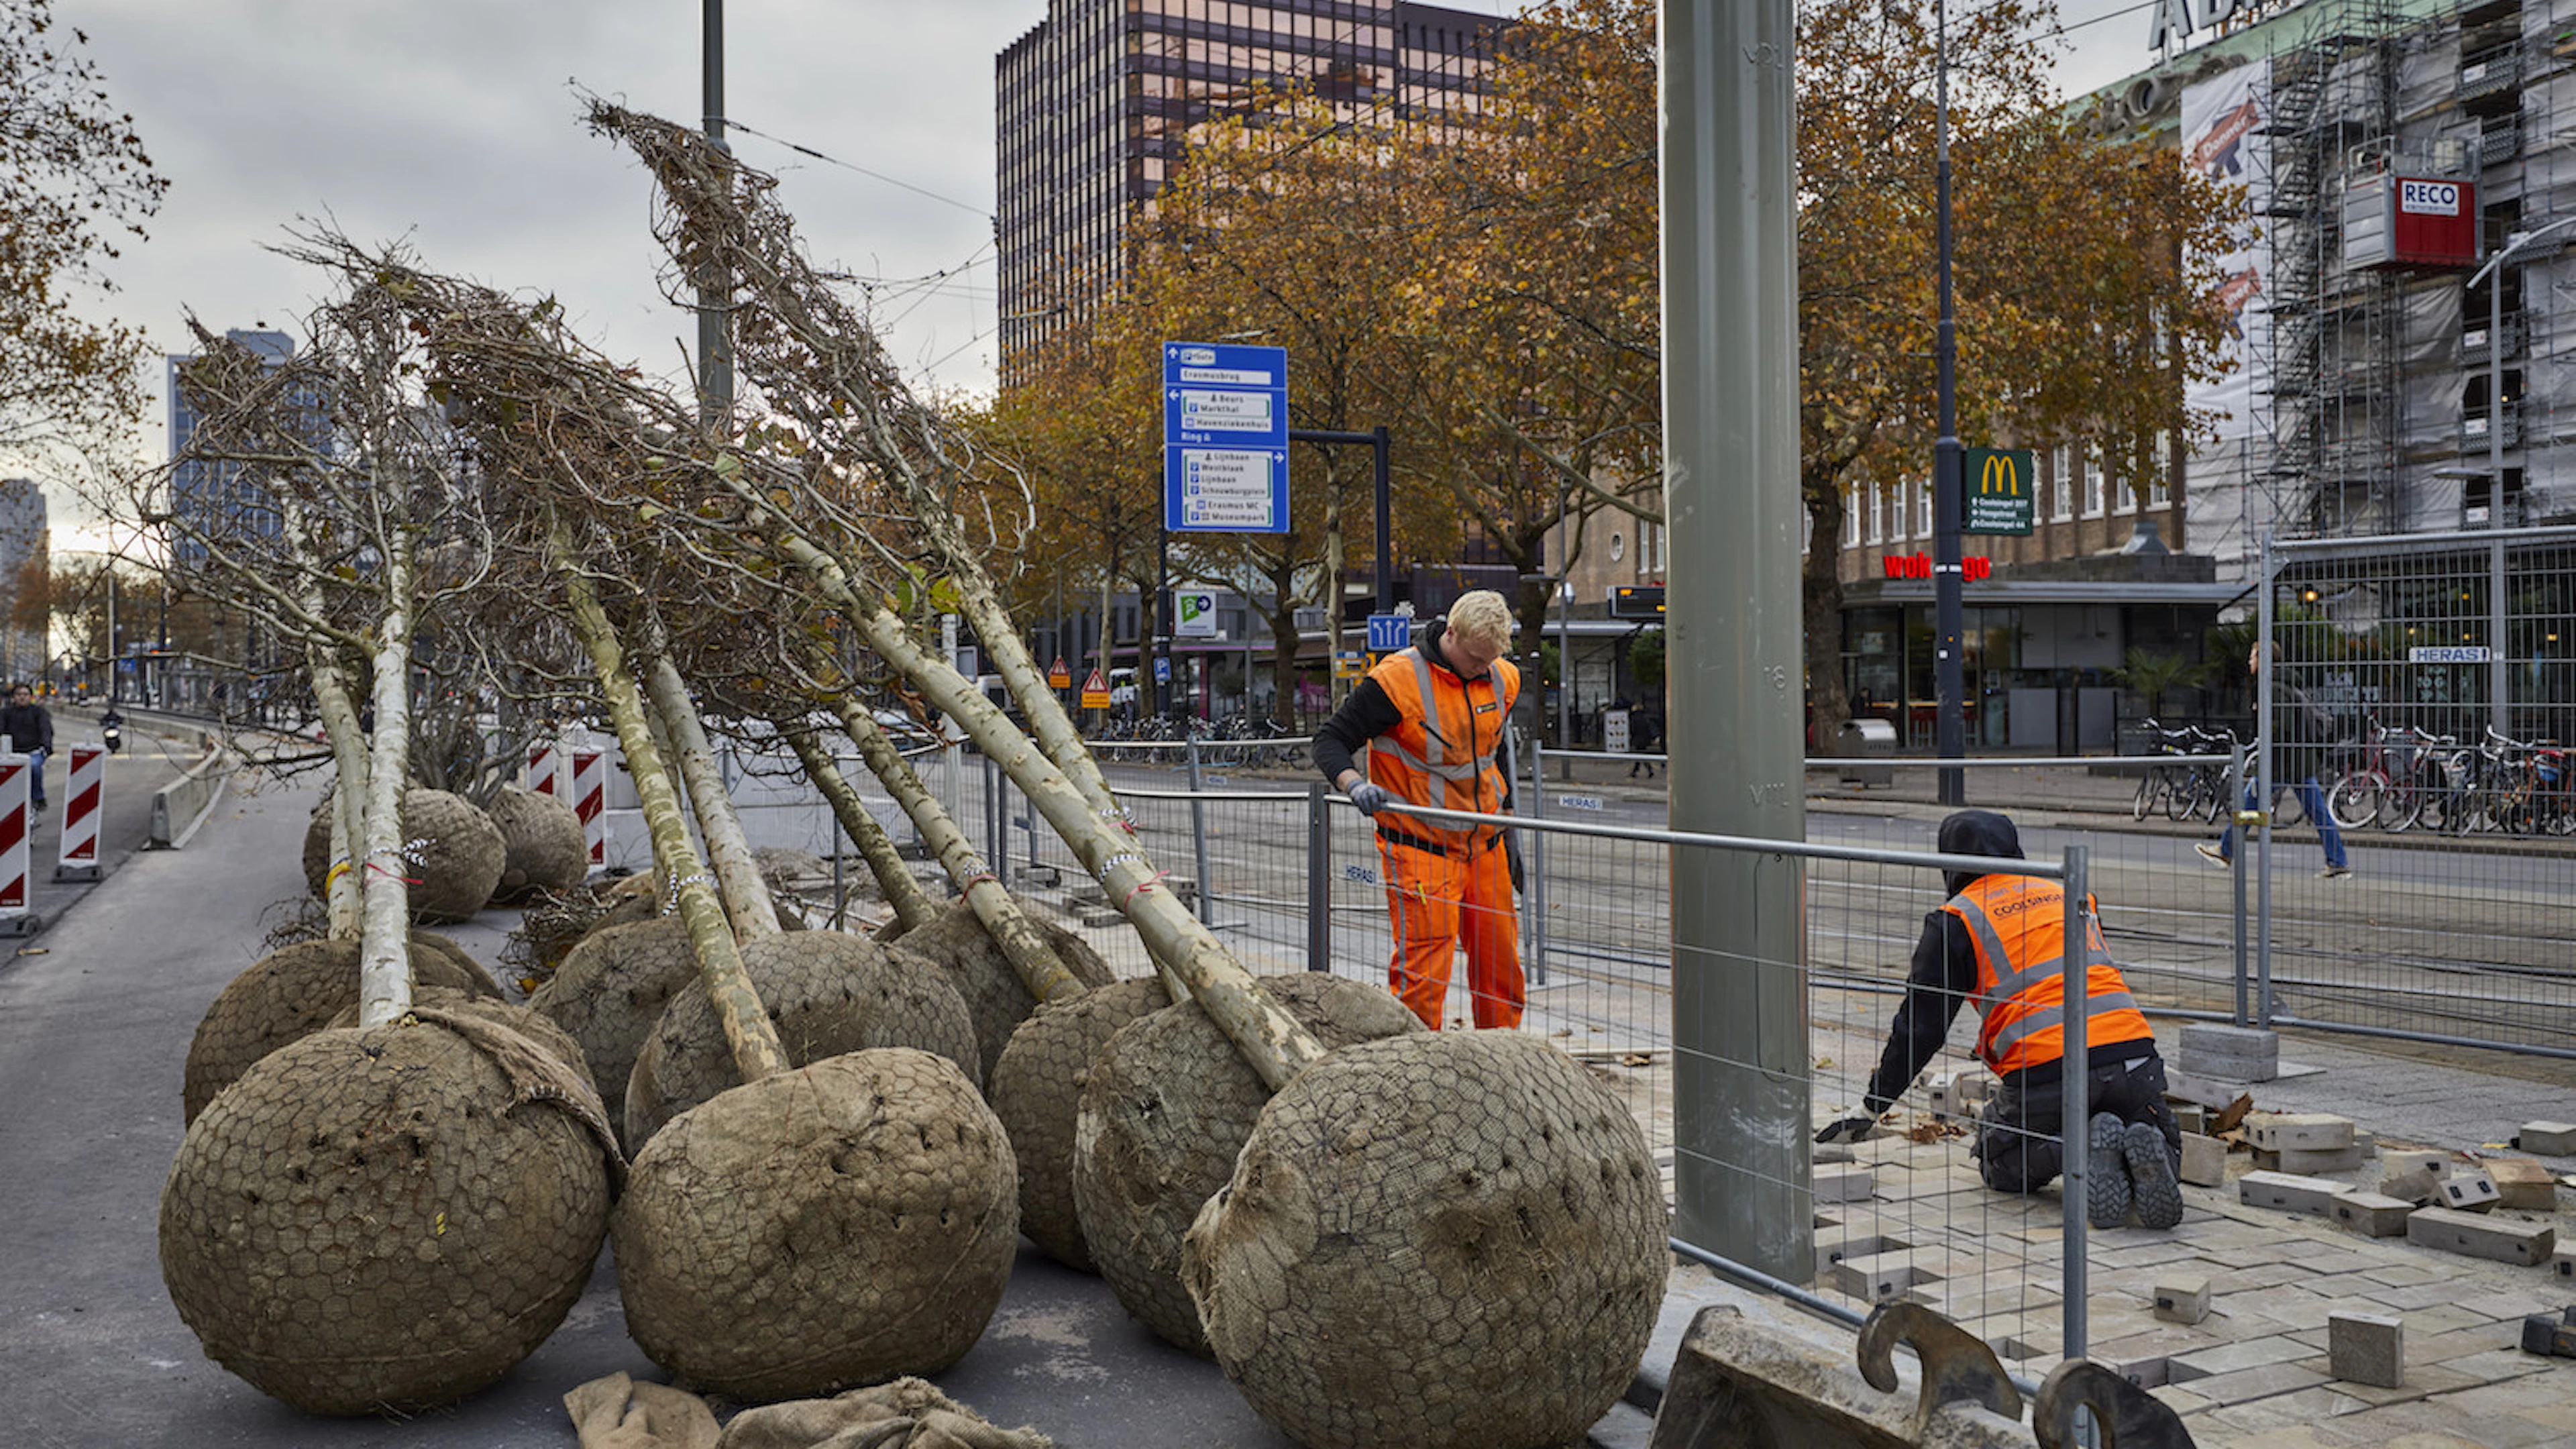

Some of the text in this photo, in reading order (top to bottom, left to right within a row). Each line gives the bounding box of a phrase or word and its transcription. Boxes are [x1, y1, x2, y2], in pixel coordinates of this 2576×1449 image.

[2406, 184, 2455, 204] RECO
[1183, 370, 1240, 382] Erasmusbrug
[1219, 394, 1244, 403] Beurs
[1199, 404, 1240, 413] Markthal
[1196, 418, 1269, 429] Havenziekenhuis
[1181, 431, 1202, 443] Ring
[1214, 452, 1249, 462] Lijnbaan
[1201, 464, 1244, 473] Westblaak
[1201, 475, 1236, 484] Lijnbaan
[1201, 486, 1266, 497] Schouwburgplein
[1208, 500, 1244, 510] Erasmus
[1212, 512, 1265, 522] Museumpark
[1884, 551, 1990, 582] wok go
[2416, 648, 2479, 661] HERAS
